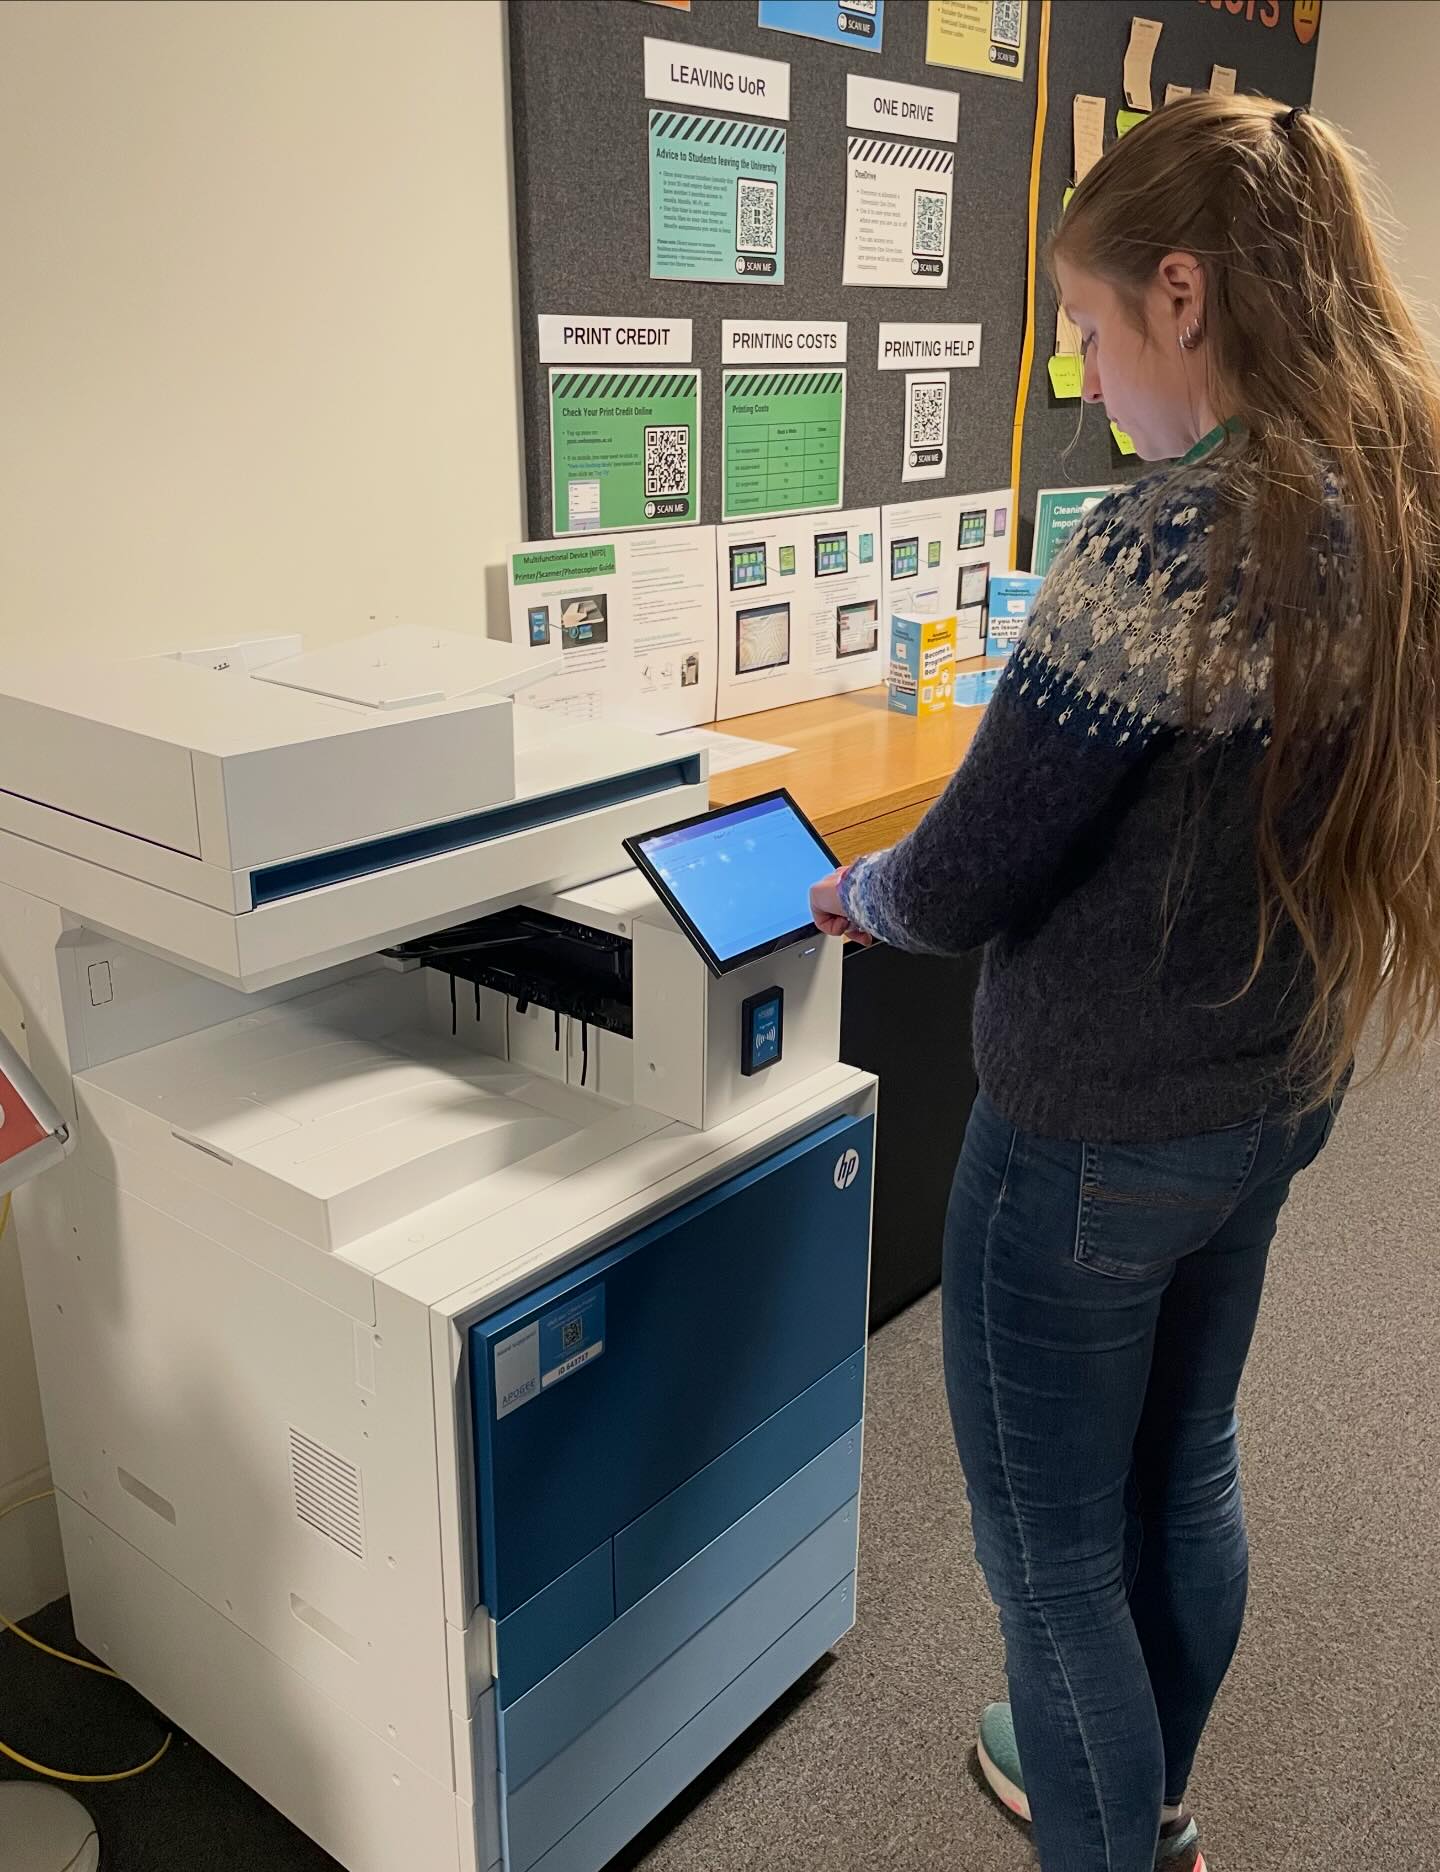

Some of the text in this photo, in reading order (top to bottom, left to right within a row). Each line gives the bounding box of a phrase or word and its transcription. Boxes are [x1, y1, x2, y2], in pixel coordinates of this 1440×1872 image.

[848, 18, 871, 34] SCAN ME
[671, 63, 766, 97] LEAVING UoR
[873, 97, 934, 122] ONE DRIVE
[656, 148, 777, 175] Advice to Students leaving the University
[854, 169, 877, 181] OneDrive
[746, 262, 772, 272] SCAN ME
[919, 263, 940, 273] SCAN ME
[563, 327, 670, 345] PRINT CREDIT
[732, 333, 837, 349] PRINTING COSTS
[884, 340, 975, 357] PRINTING HELP
[562, 407, 652, 417] Check Your Print Credit Online
[732, 404, 769, 415] Printing Costs
[919, 453, 939, 463] SCAN ME
[657, 503, 684, 514] SCAN ME
[1053, 505, 1084, 515] Cleanin
[1052, 519, 1080, 530] Import
[523, 553, 568, 564] Multifunctional
[569, 551, 588, 560] Device
[514, 562, 615, 580] Printer/Scanner/Photocopier Guide
[836, 1150, 858, 1189] hp
[558, 1366, 566, 1375] ID
[502, 1378, 535, 1403] APOGEE
